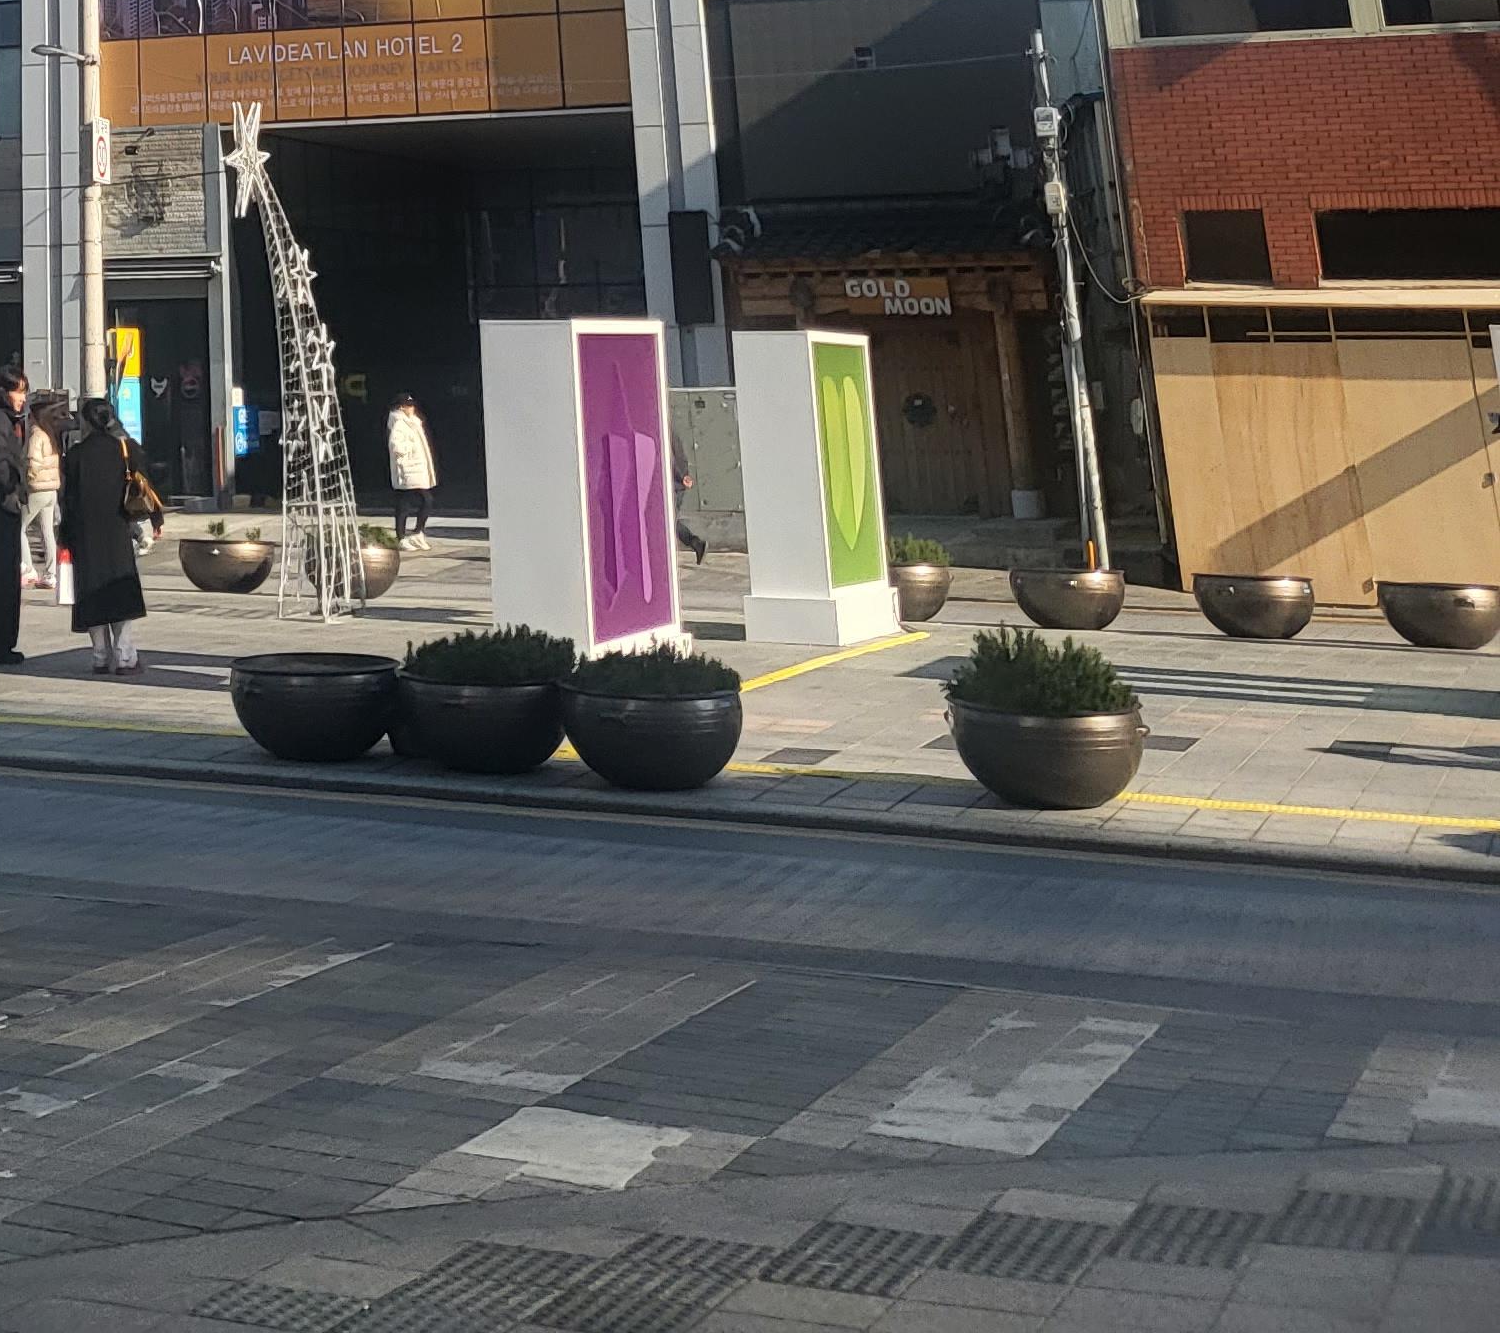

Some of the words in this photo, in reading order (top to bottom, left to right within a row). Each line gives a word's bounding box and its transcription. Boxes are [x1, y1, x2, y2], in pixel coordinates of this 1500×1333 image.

[227, 41, 368, 66] LAVIDEATLAN
[376, 37, 444, 56] HOTEL
[451, 33, 464, 53] 2
[844, 278, 911, 298] GOLD
[884, 297, 952, 316] MOON
